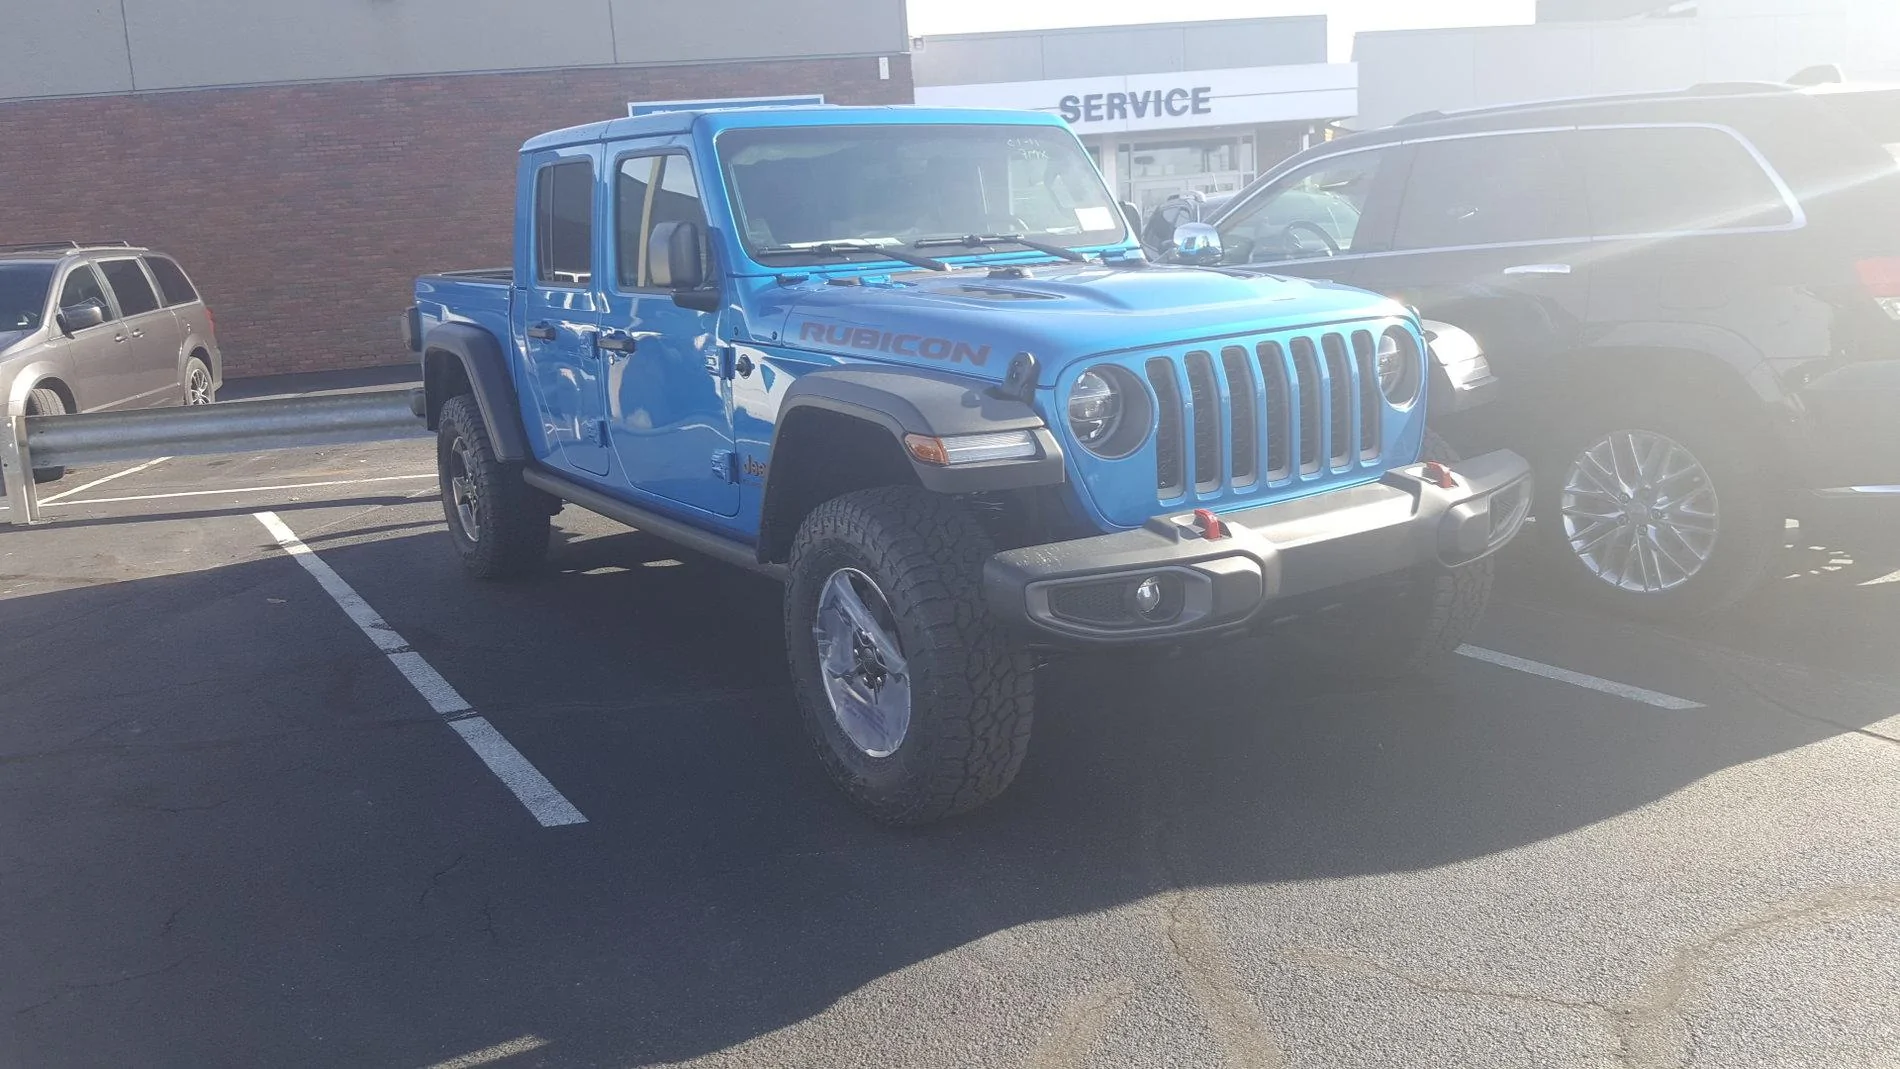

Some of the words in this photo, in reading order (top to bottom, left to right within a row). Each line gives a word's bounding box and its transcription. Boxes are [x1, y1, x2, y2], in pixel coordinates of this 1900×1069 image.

[1059, 86, 1212, 124] SERVICE
[799, 321, 993, 368] RUBICON
[743, 453, 769, 478] Jee
